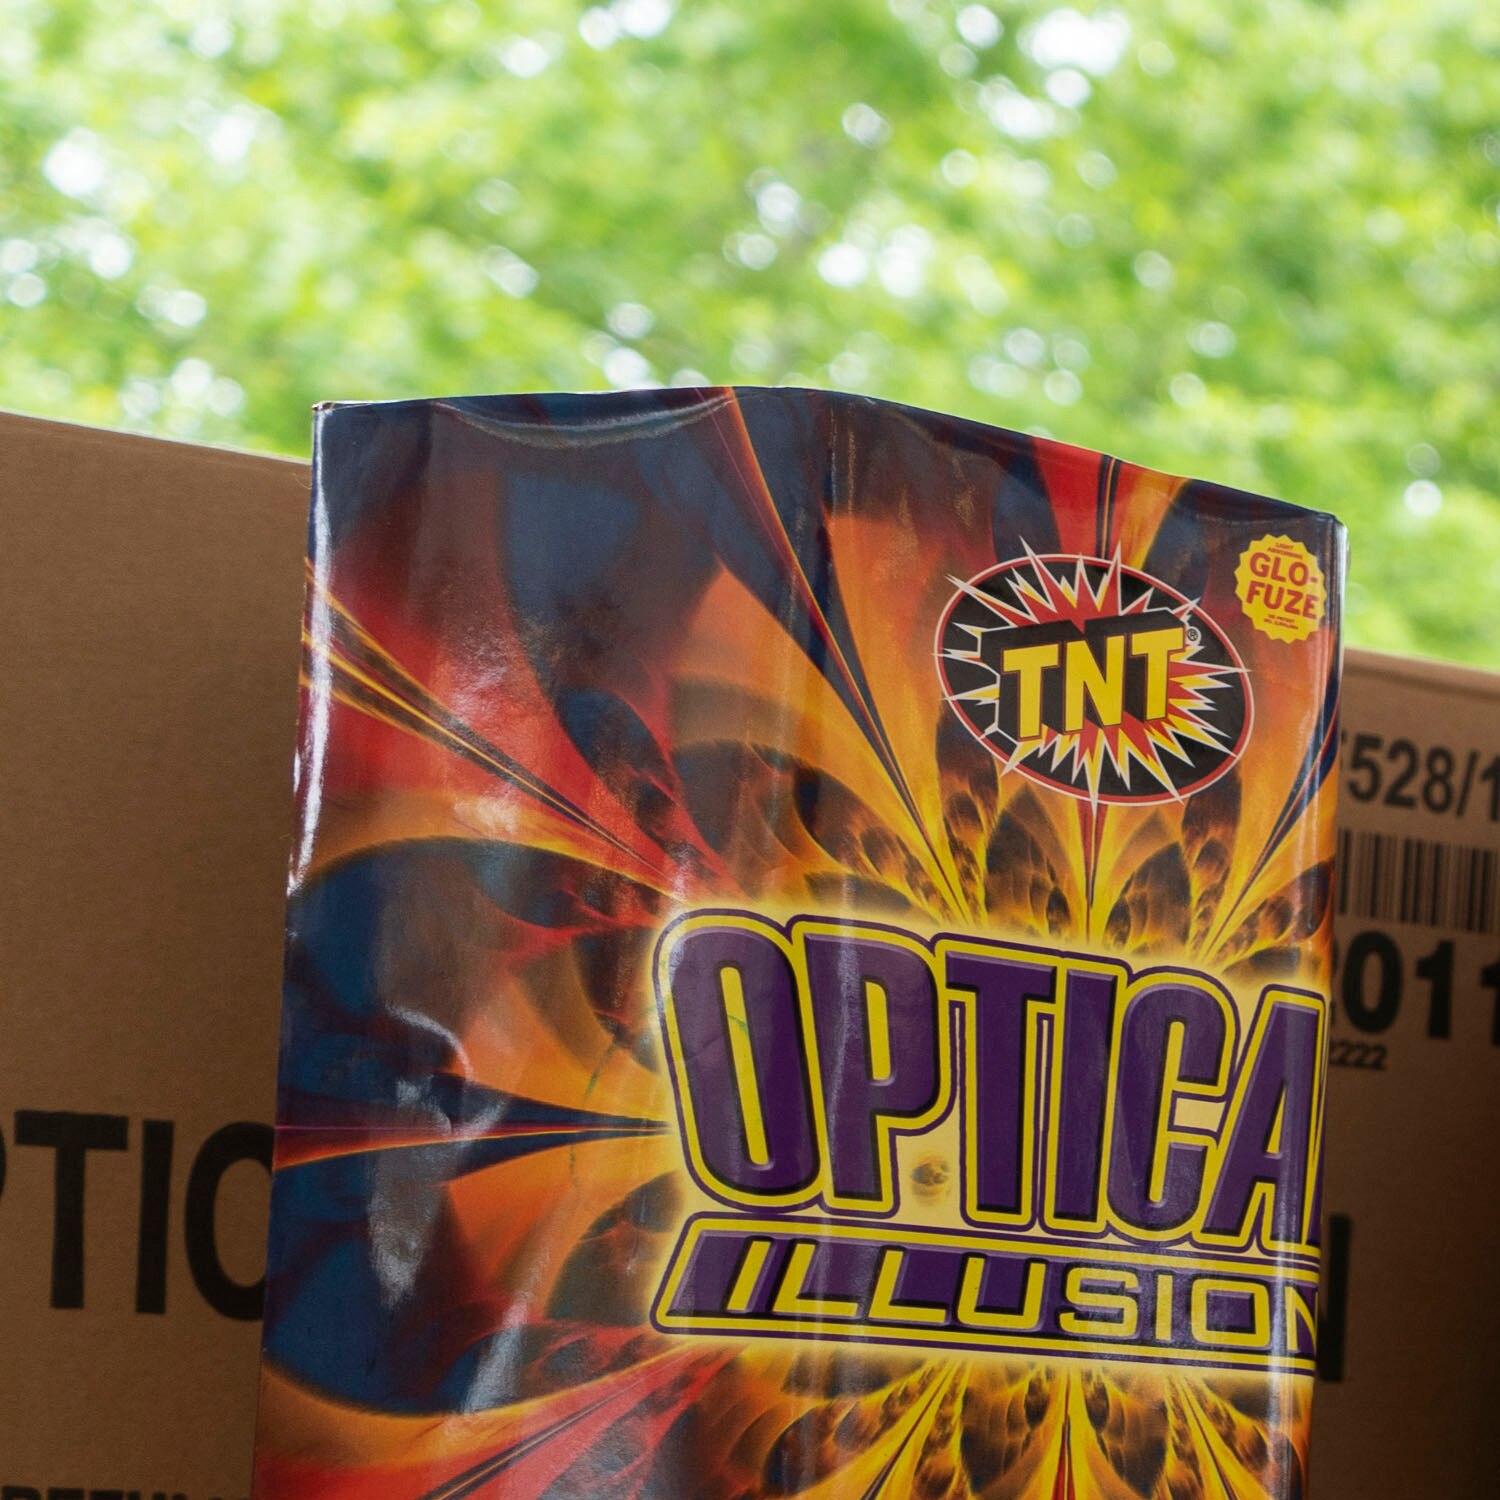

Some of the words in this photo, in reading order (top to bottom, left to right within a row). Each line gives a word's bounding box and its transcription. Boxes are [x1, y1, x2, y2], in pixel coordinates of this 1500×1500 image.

[1246, 580, 1320, 620] FUZE
[1249, 552, 1318, 587] GLO-
[1002, 627, 1185, 739] TNT
[656, 910, 1325, 1252] OPTICA
[0, 1110, 275, 1322] TIC
